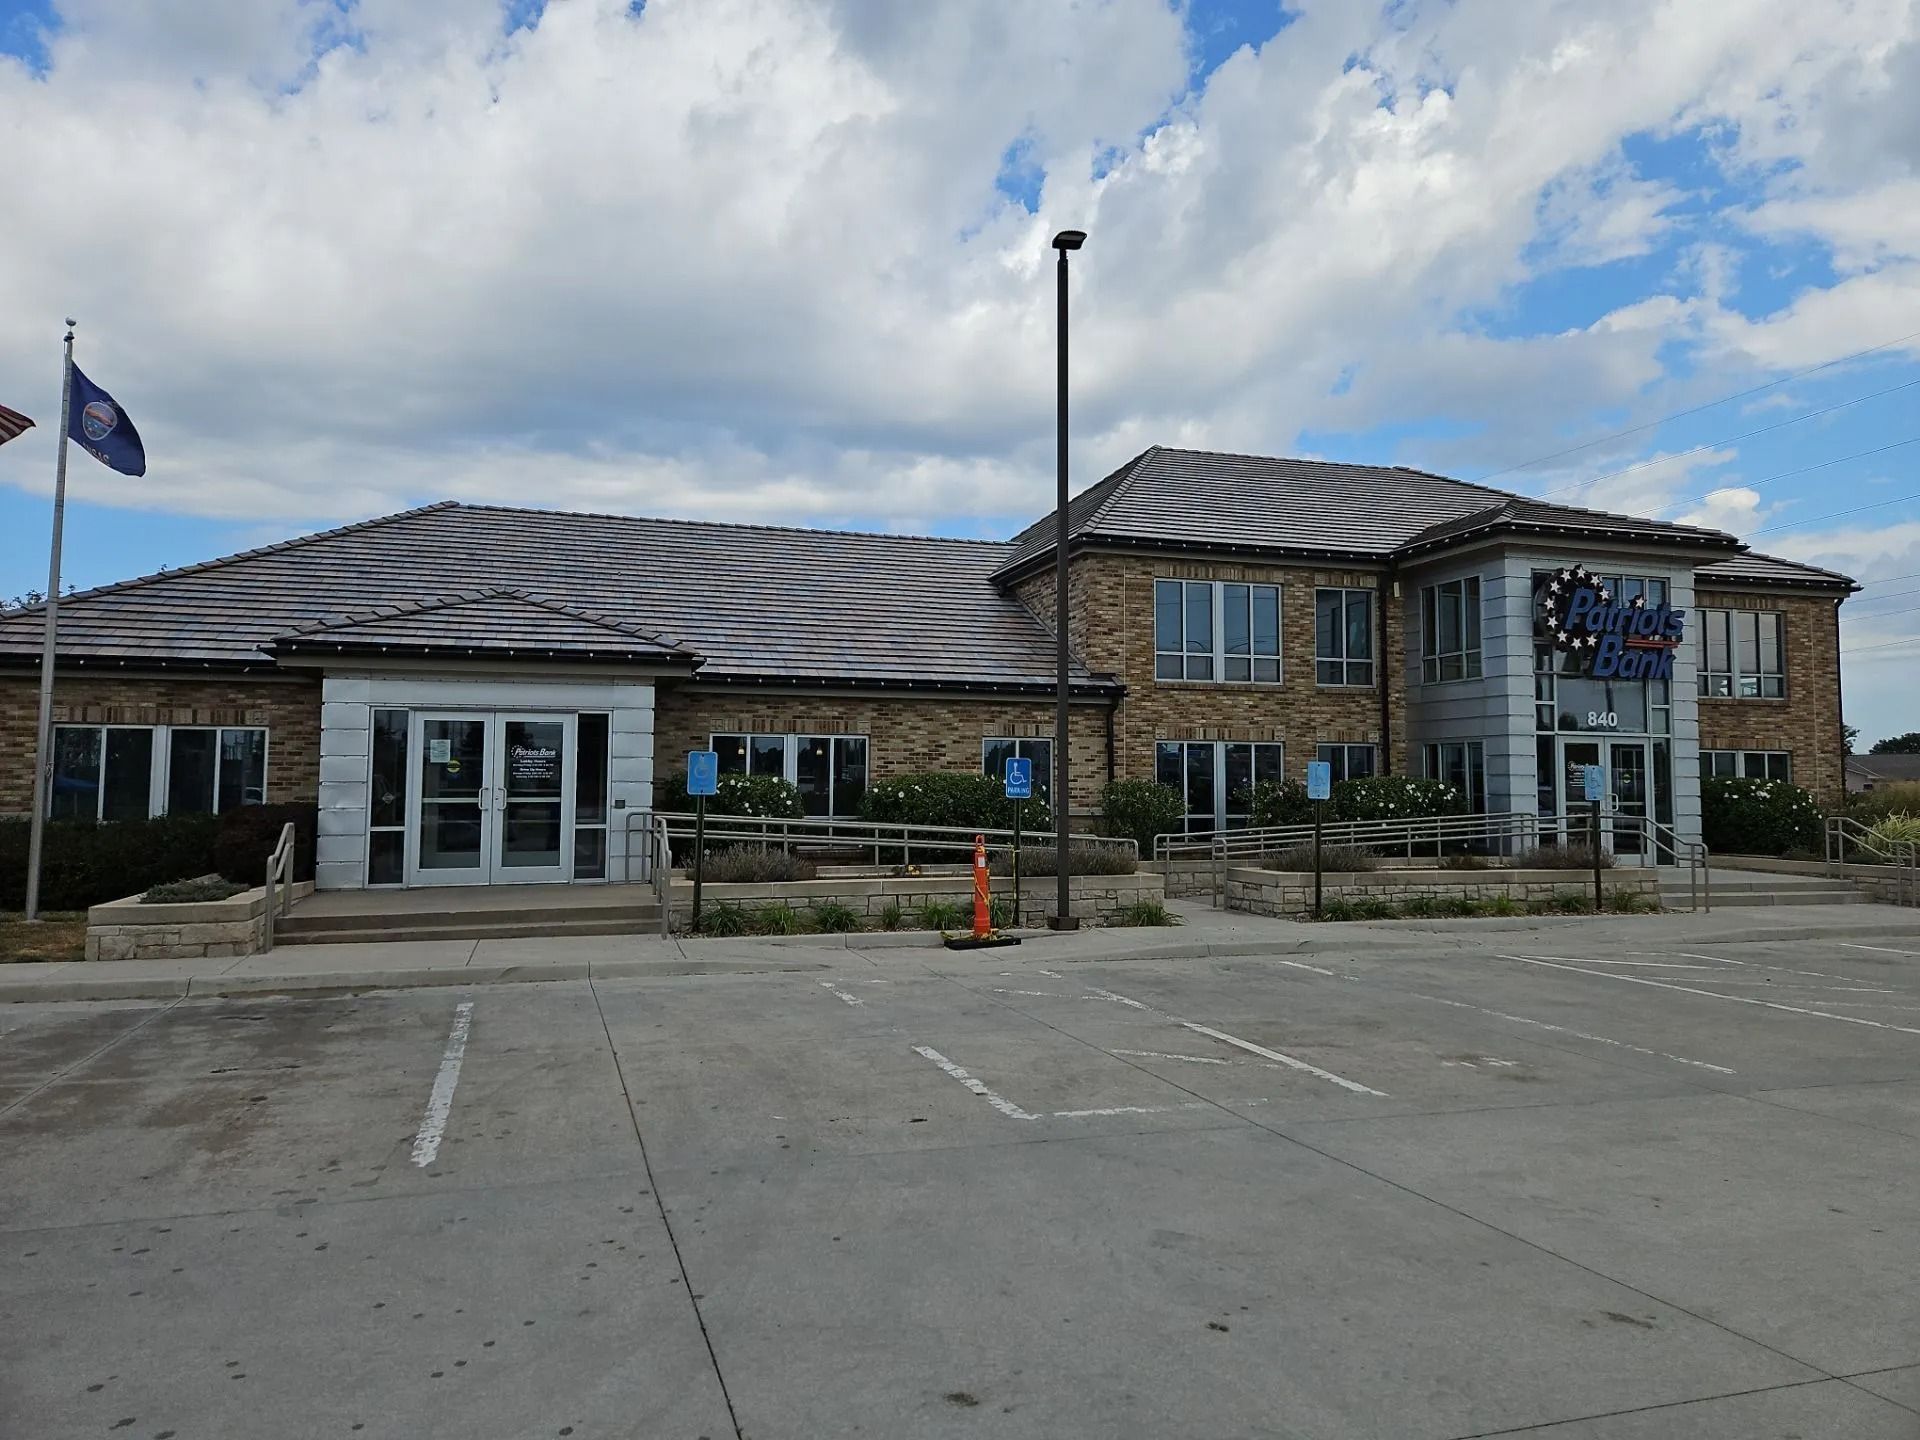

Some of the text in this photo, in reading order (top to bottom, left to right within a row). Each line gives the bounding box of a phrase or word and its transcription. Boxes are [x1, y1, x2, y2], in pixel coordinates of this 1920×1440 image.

[1564, 587, 1686, 636] Patriots
[1592, 634, 1677, 681] Bank
[1587, 711, 1618, 727] 840
[514, 748, 556, 757] Patriots Bank
